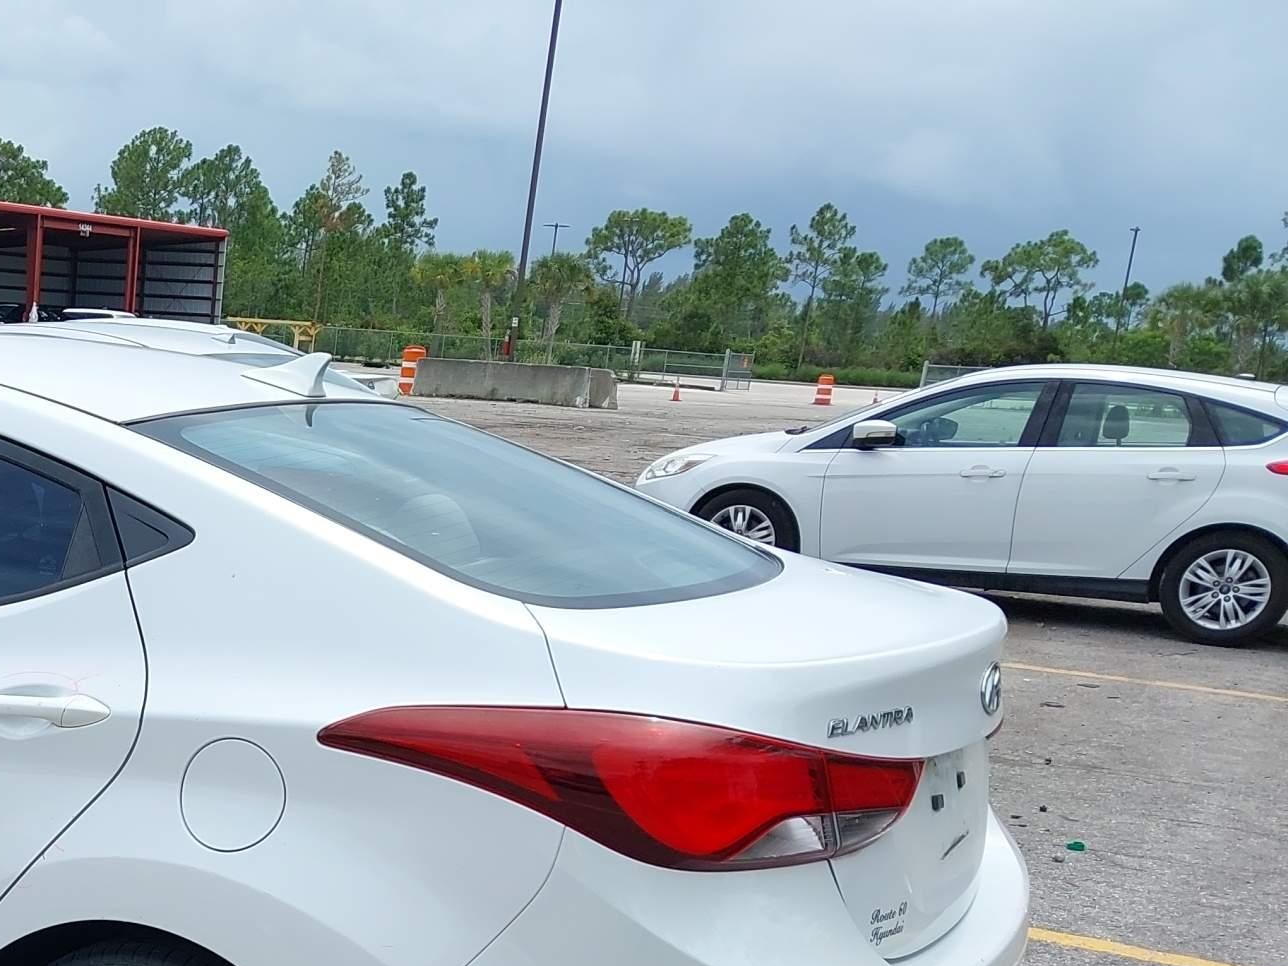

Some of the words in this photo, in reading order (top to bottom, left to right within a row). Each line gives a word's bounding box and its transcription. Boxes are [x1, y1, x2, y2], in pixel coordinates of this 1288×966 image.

[827, 706, 913, 738] ELANTRA
[870, 908, 897, 925] Route
[869, 920, 904, 946] Hyundai
